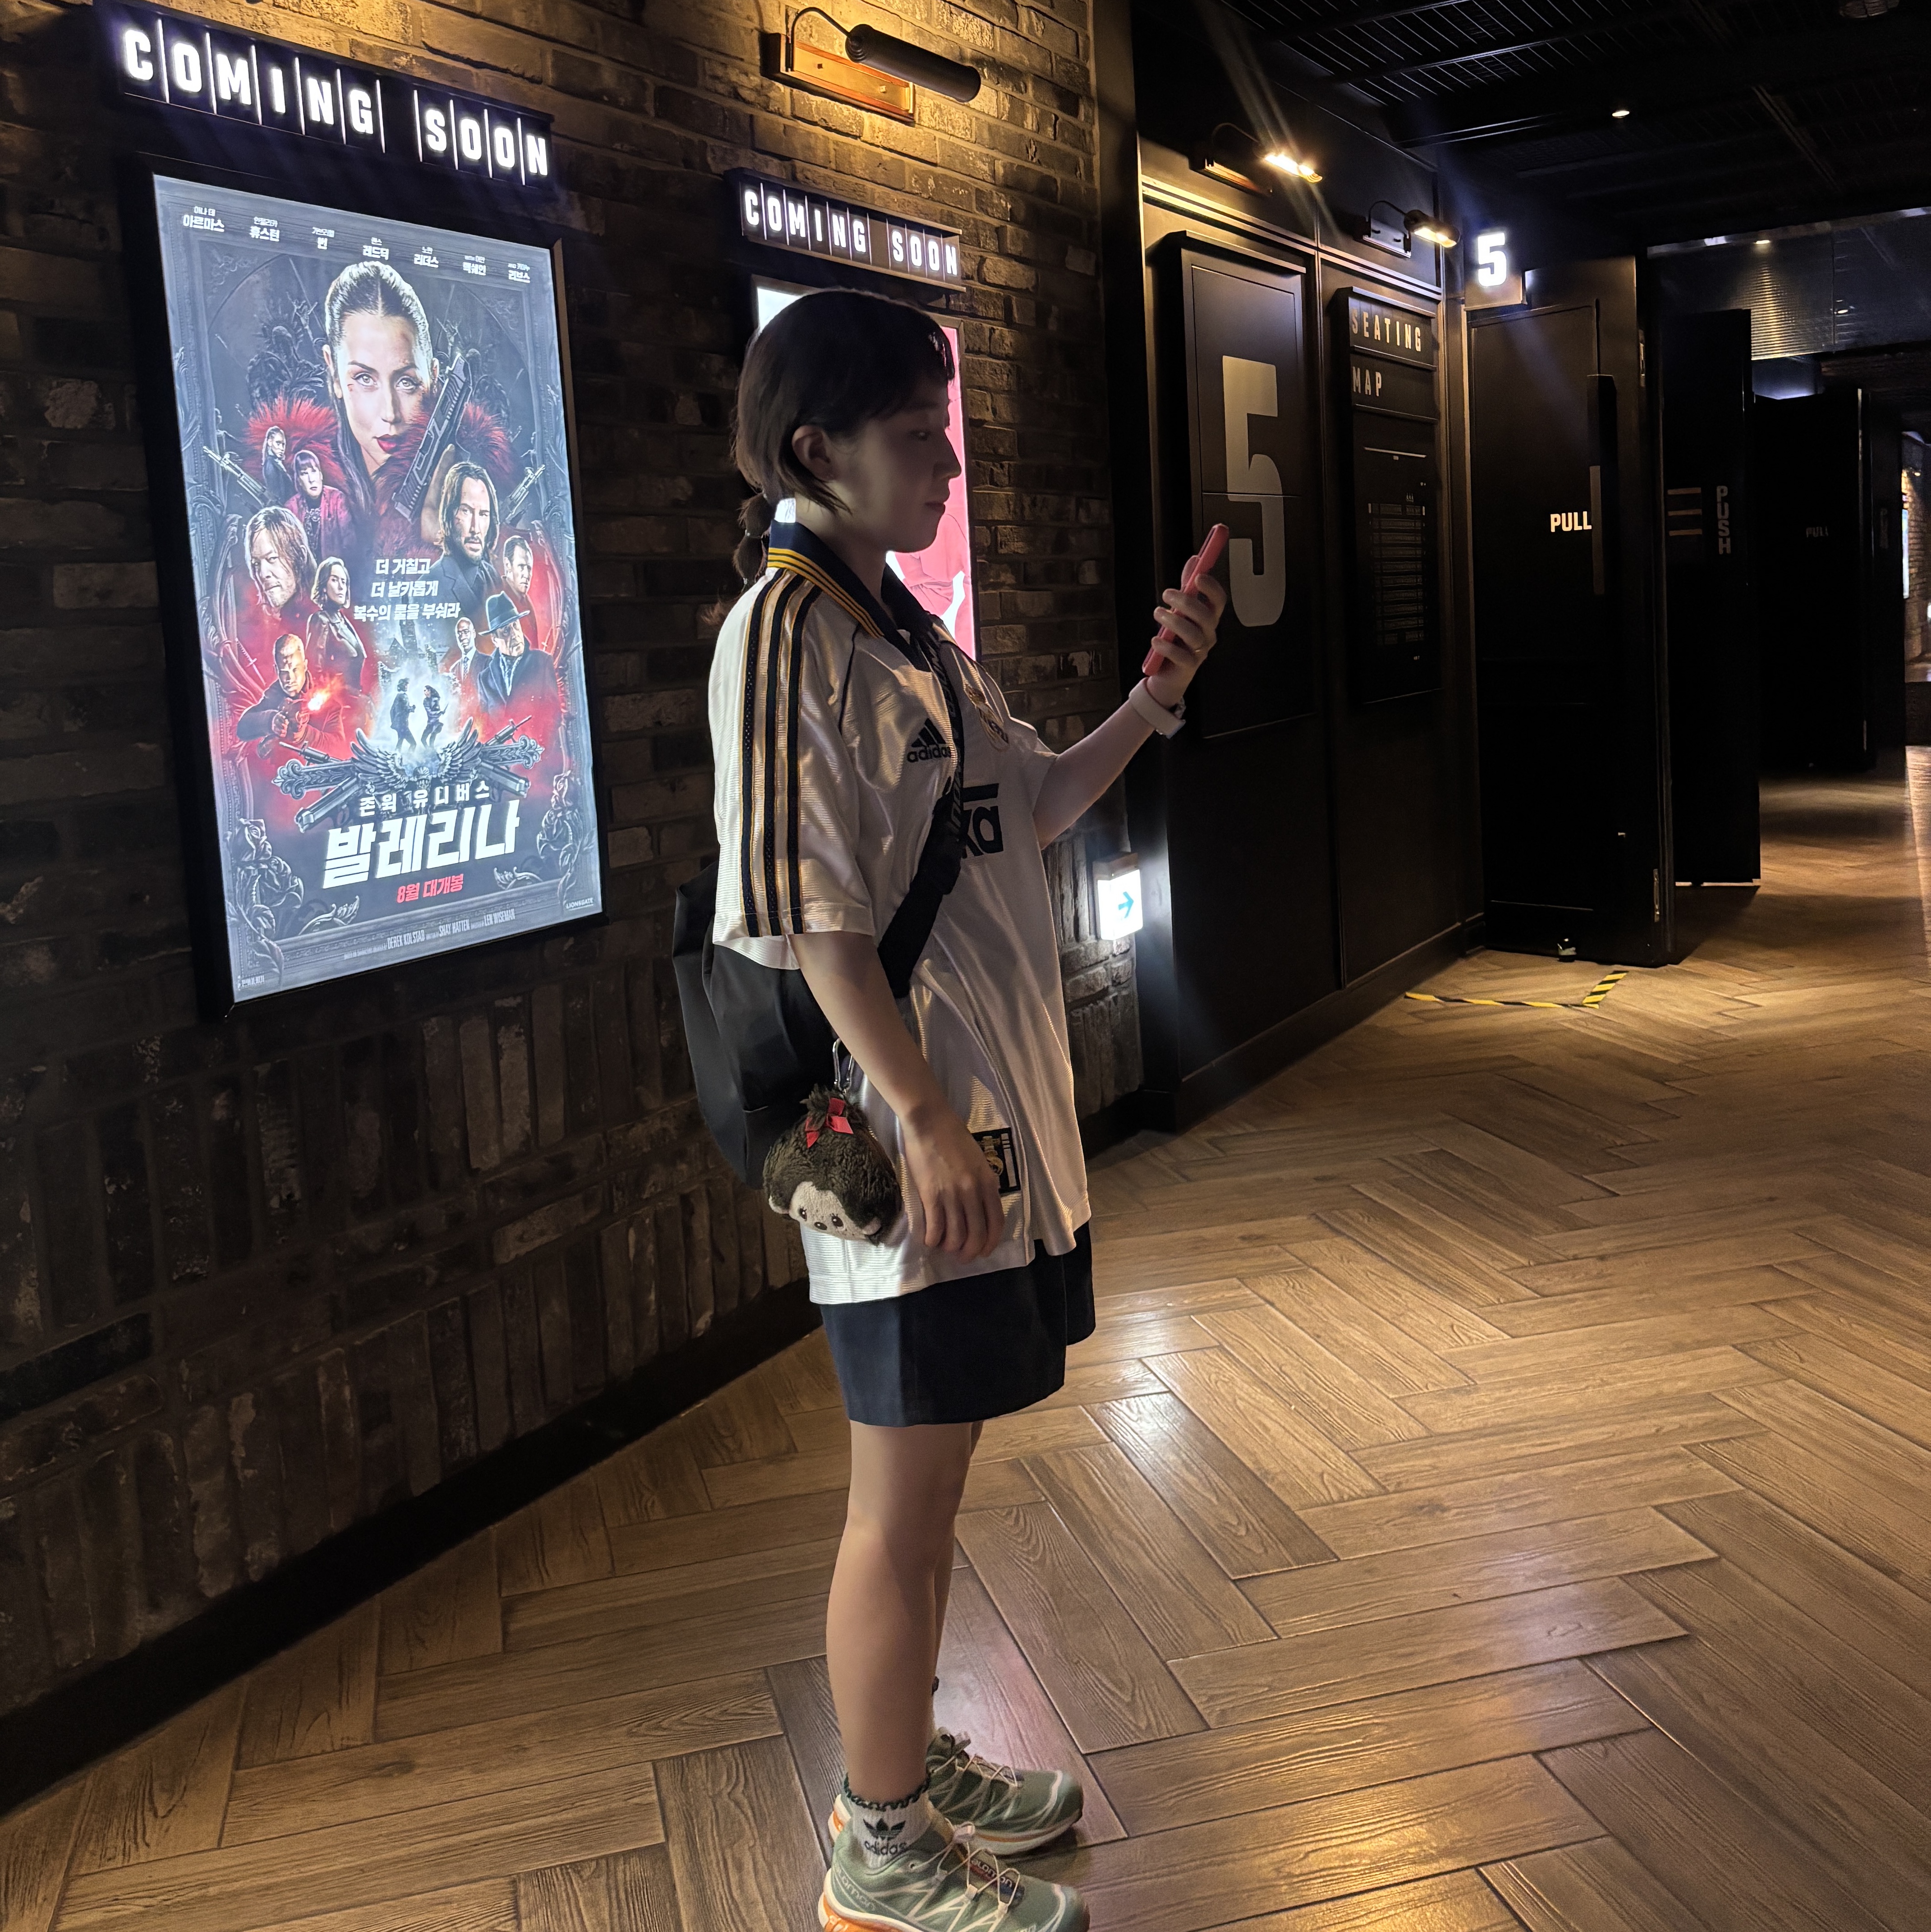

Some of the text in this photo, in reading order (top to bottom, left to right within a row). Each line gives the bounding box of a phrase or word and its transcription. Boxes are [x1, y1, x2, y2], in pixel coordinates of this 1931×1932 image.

[124, 29, 549, 176] COMING SOON
[183, 214, 225, 232] 아르마스
[249, 226, 280, 242] 휴스턴
[744, 190, 958, 276] COMING SOON
[1477, 232, 1507, 287] 5
[1352, 309, 1421, 352] SEATING
[1353, 366, 1382, 396] MAP
[1222, 355, 1287, 627] 5
[1550, 511, 1592, 532] PULL
[1716, 486, 1731, 554] PUSH
[376, 558, 431, 574] 더 거칠고
[371, 580, 439, 597] 더 날카롭게
[354, 605, 391, 622] 복수의
[322, 799, 520, 889] 발레리나
[397, 874, 464, 903] 8월 대개봉
